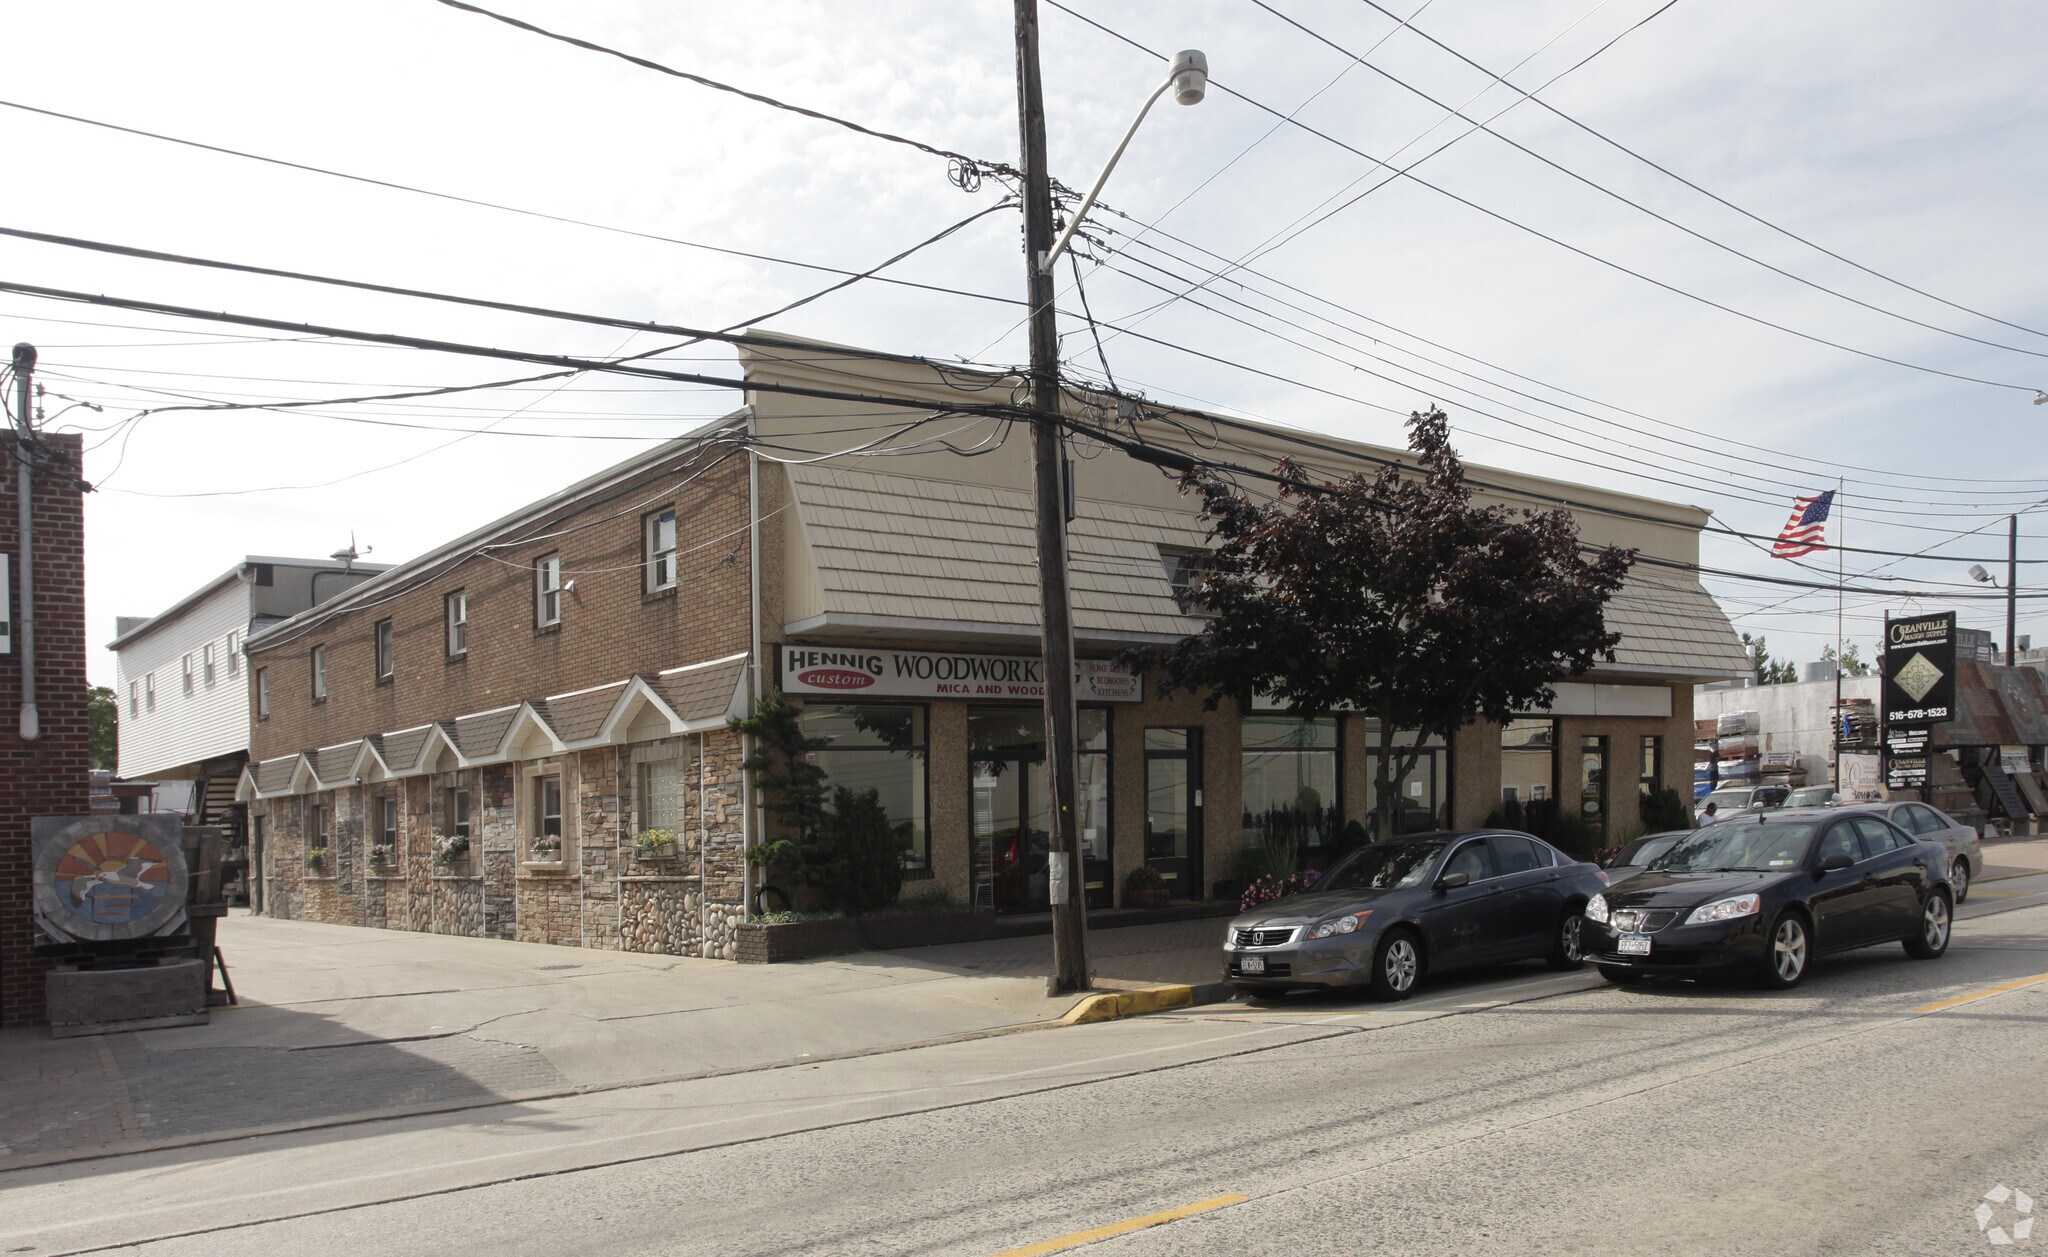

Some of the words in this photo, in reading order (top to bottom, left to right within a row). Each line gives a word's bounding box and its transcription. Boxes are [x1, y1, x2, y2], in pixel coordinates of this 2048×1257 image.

[1904, 632, 1925, 641] MASON
[1926, 629, 1947, 638] SUPPLY
[789, 650, 883, 676] HENNIG
[893, 654, 1080, 684] WOODWORK
[1089, 664, 1108, 673] HOME
[807, 673, 865, 686] custom
[1096, 676, 1130, 685] BEDROOMS
[936, 683, 970, 694] MICA
[976, 684, 1002, 695] AND
[1097, 687, 1130, 697] KITCHENS
[1889, 707, 1948, 721] 516-678-1523
